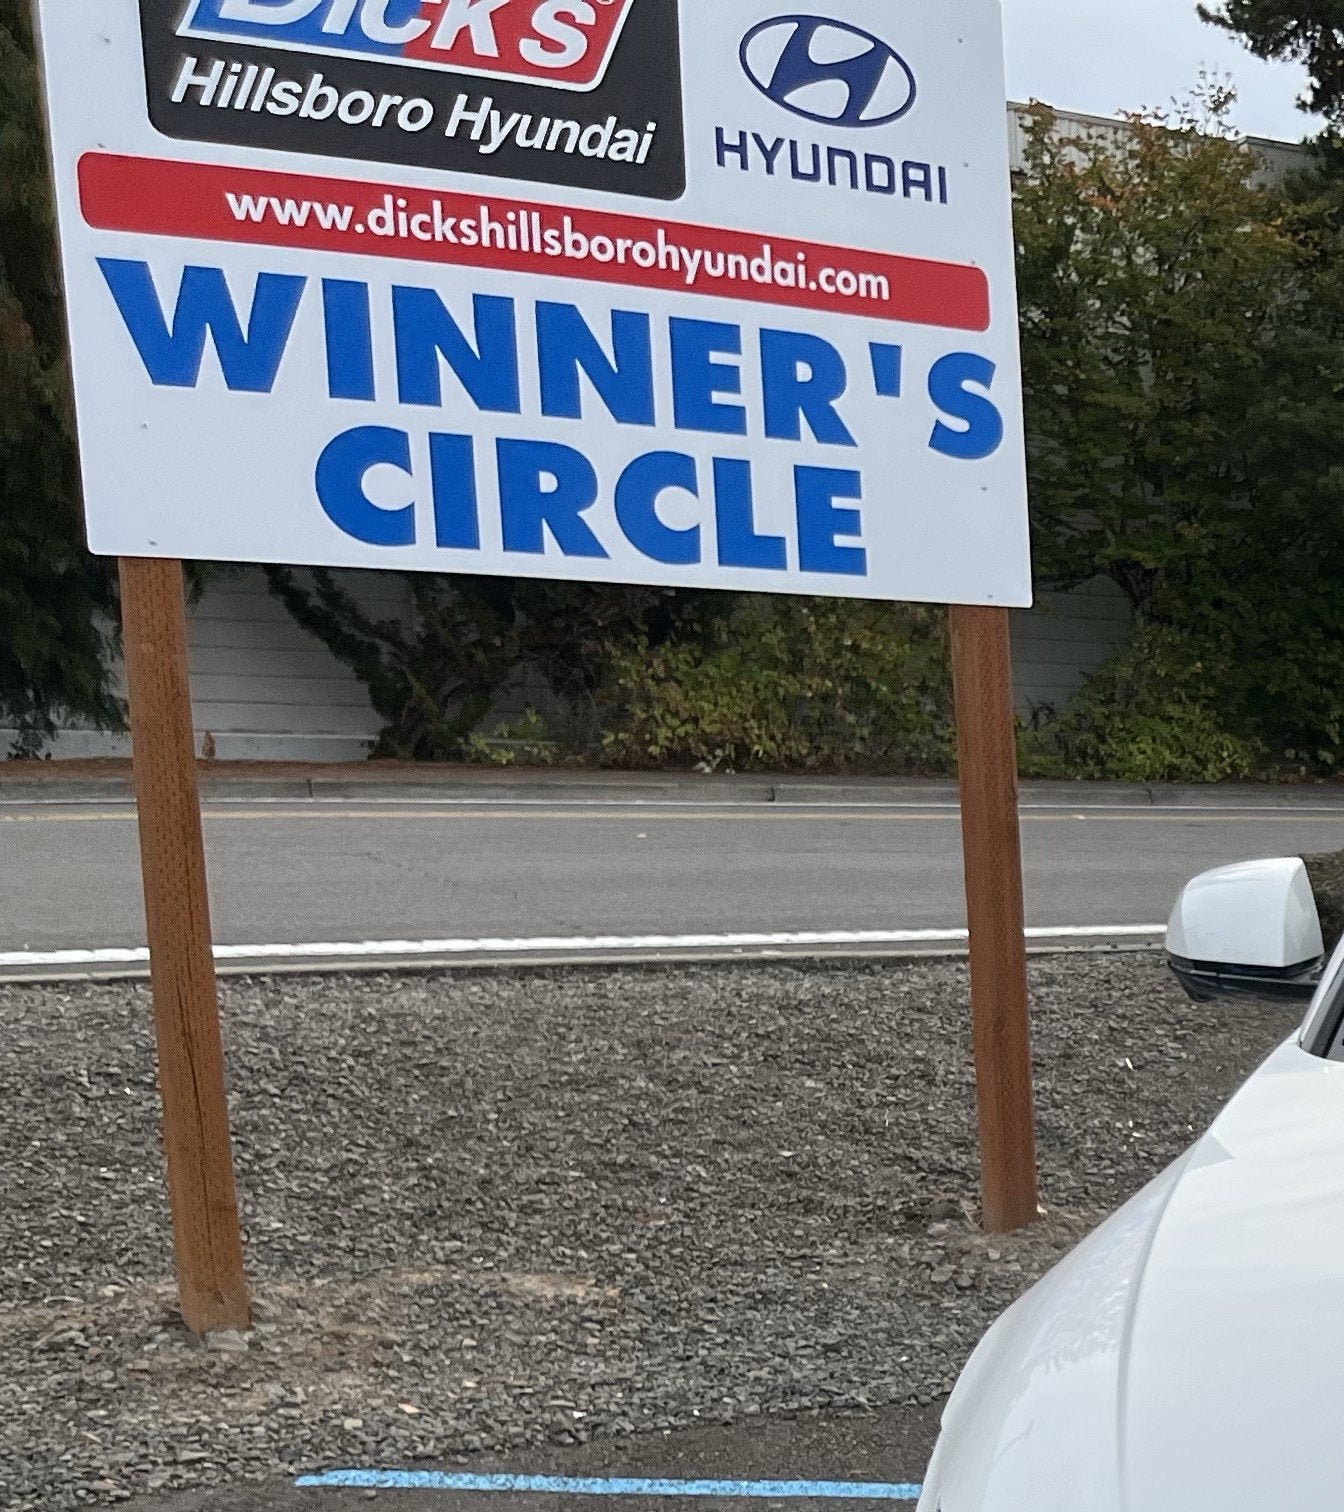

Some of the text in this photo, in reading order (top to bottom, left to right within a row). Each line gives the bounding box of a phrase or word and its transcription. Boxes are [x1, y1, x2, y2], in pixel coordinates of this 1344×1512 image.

[171, 57, 657, 165] Hillsboro Hyundai
[715, 126, 947, 204] HYUNDAI
[226, 191, 890, 302] www.dickshillsborohyundai.com
[96, 256, 1004, 460] WINNER'S
[315, 425, 867, 577] CIRCLE
